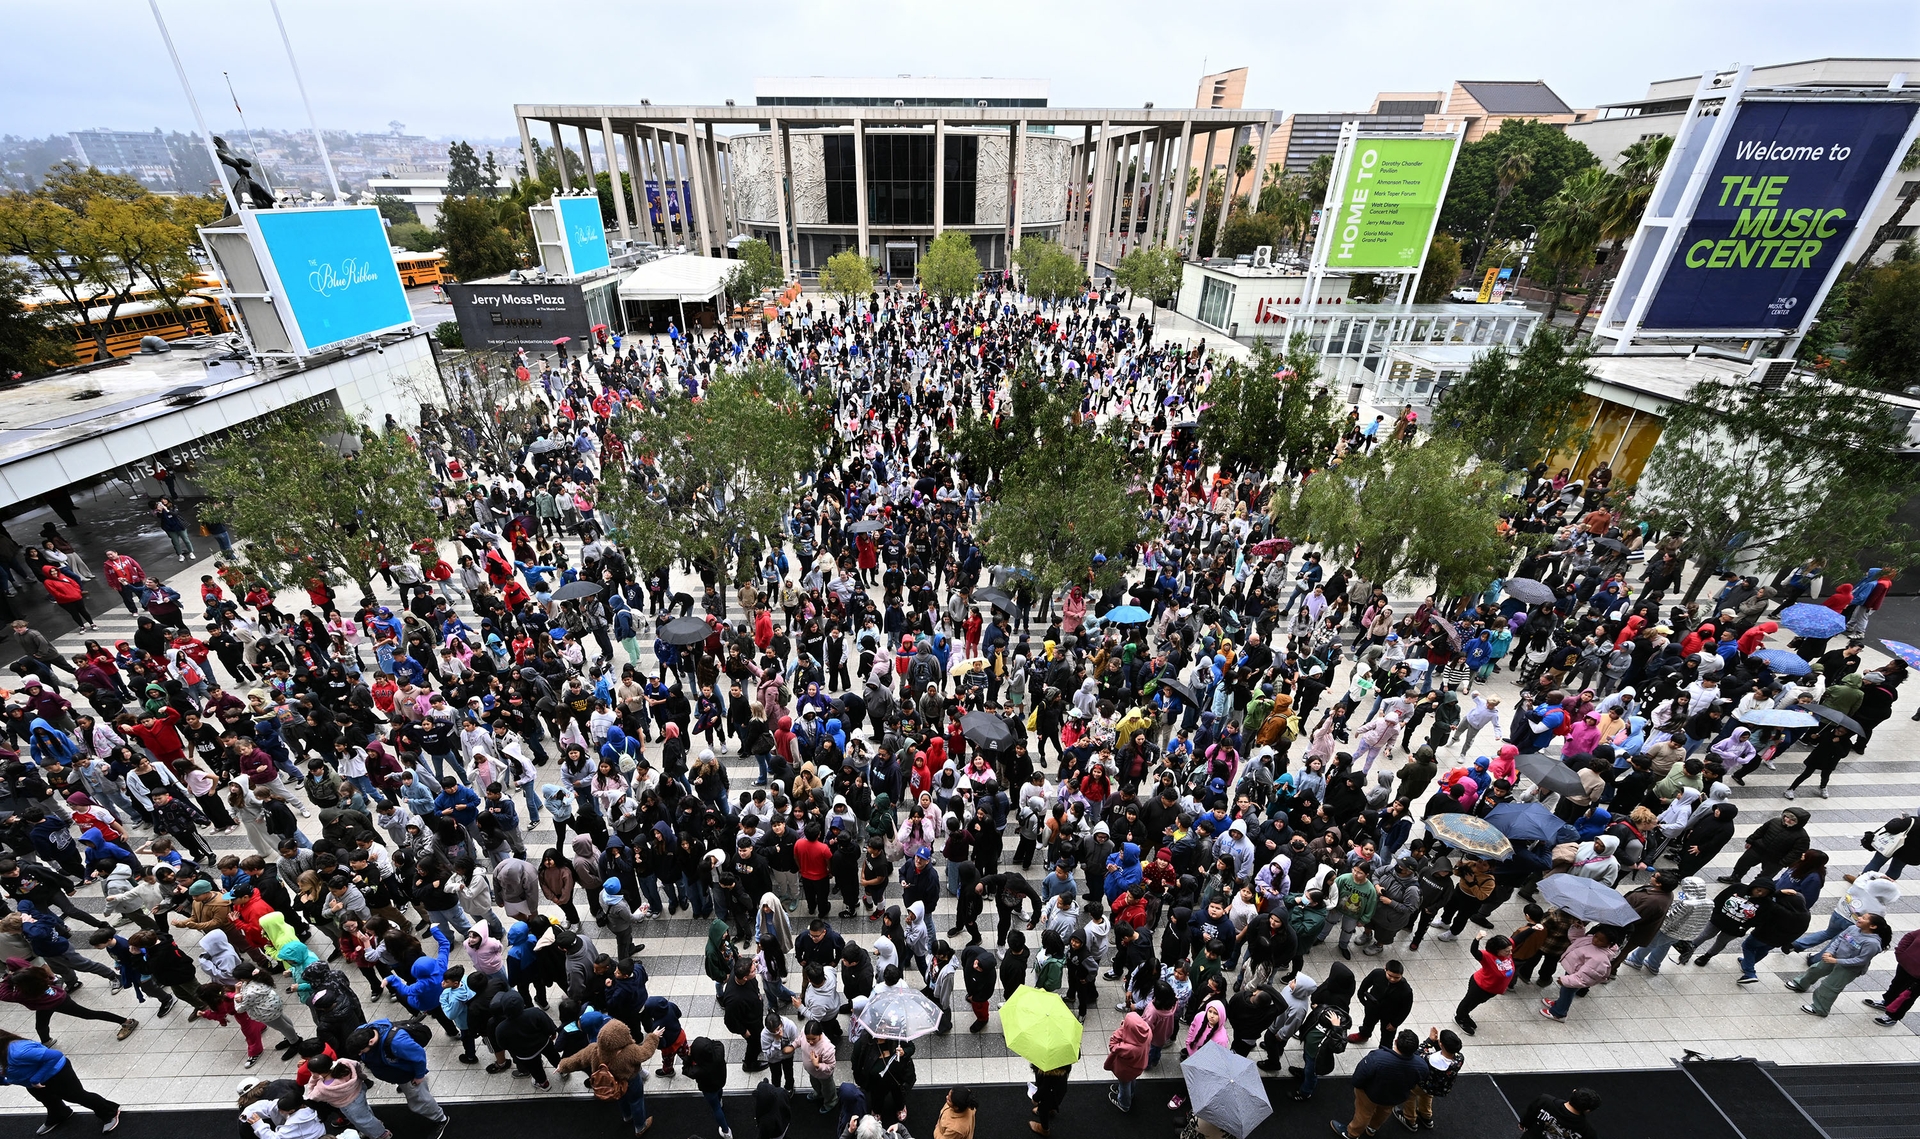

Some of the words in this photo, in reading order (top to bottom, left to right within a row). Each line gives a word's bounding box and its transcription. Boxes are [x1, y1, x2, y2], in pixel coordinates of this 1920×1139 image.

[1736, 141, 1823, 161] Welcome
[1829, 143, 1851, 161] to
[1718, 176, 1789, 207] THE
[1338, 189, 1369, 258] HOME
[1357, 149, 1378, 183] TO
[1729, 208, 1847, 238] MUSIC
[1685, 239, 1823, 268] CENTER
[309, 263, 346, 297] Blue
[341, 258, 378, 291] Ribbon
[472, 294, 500, 307] Jerry
[502, 294, 532, 305] Moss
[533, 294, 565, 305] Plaza
[130, 462, 167, 482] LISA
[382, 652, 393, 661] 23
[375, 690, 393, 698] GAP
[1113, 804, 1126, 815] GA
[1221, 840, 1242, 854] UCLA
